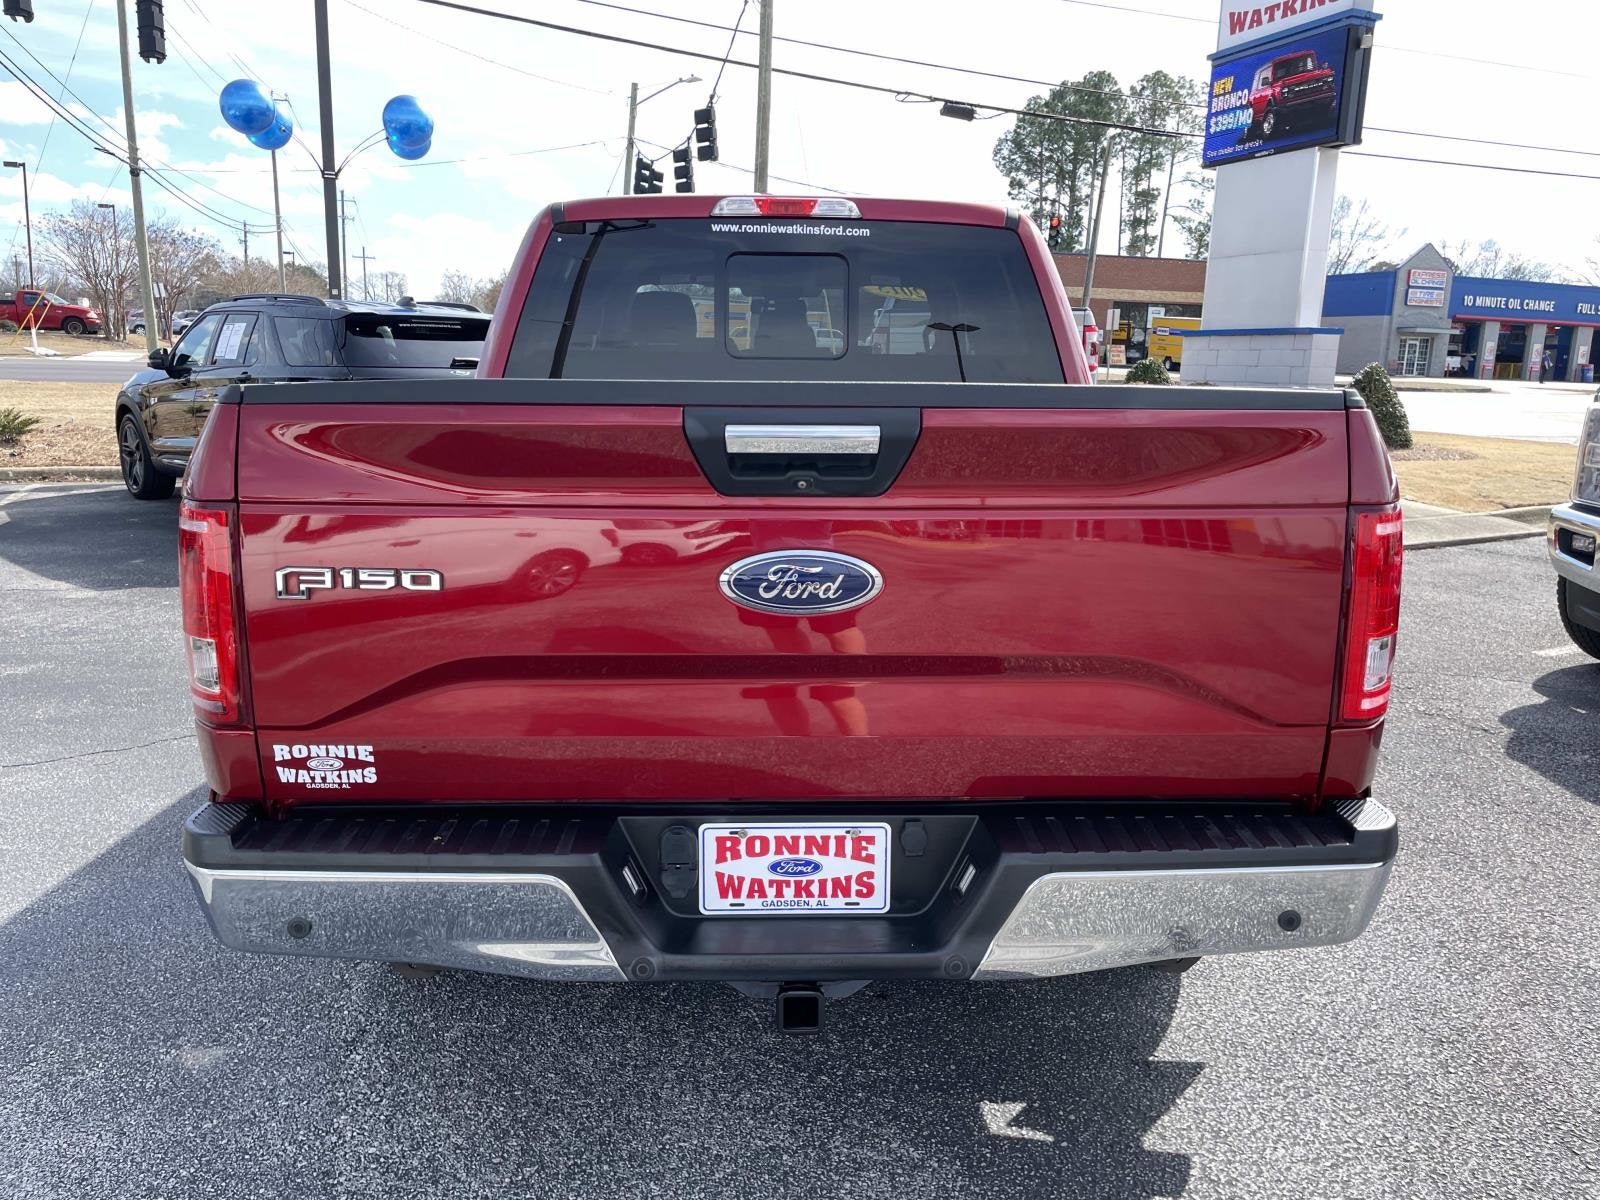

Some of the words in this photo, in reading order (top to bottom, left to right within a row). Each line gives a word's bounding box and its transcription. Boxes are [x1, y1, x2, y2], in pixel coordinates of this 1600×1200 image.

[1229, 0, 1338, 35] WATKIN
[1213, 76, 1234, 96] NEW
[1211, 89, 1249, 113] BRONCO
[711, 223, 870, 237] www.ronniewatkinsford.com
[1419, 290, 1436, 298] TIRE
[1463, 295, 1473, 307] 10
[1475, 296, 1506, 309] MINUTE
[1508, 298, 1522, 310] OIL
[1523, 299, 1555, 312] CHANGE
[1577, 303, 1595, 315] FULL
[759, 564, 845, 599] Ford
[273, 744, 375, 763] RONNIE
[315, 760, 336, 768] Ford
[276, 766, 377, 784] WATKINS
[715, 835, 876, 864] RONNIE
[776, 860, 814, 874] Ford
[715, 871, 876, 899] WATKINS
[762, 900, 813, 908] GADSDEN,
